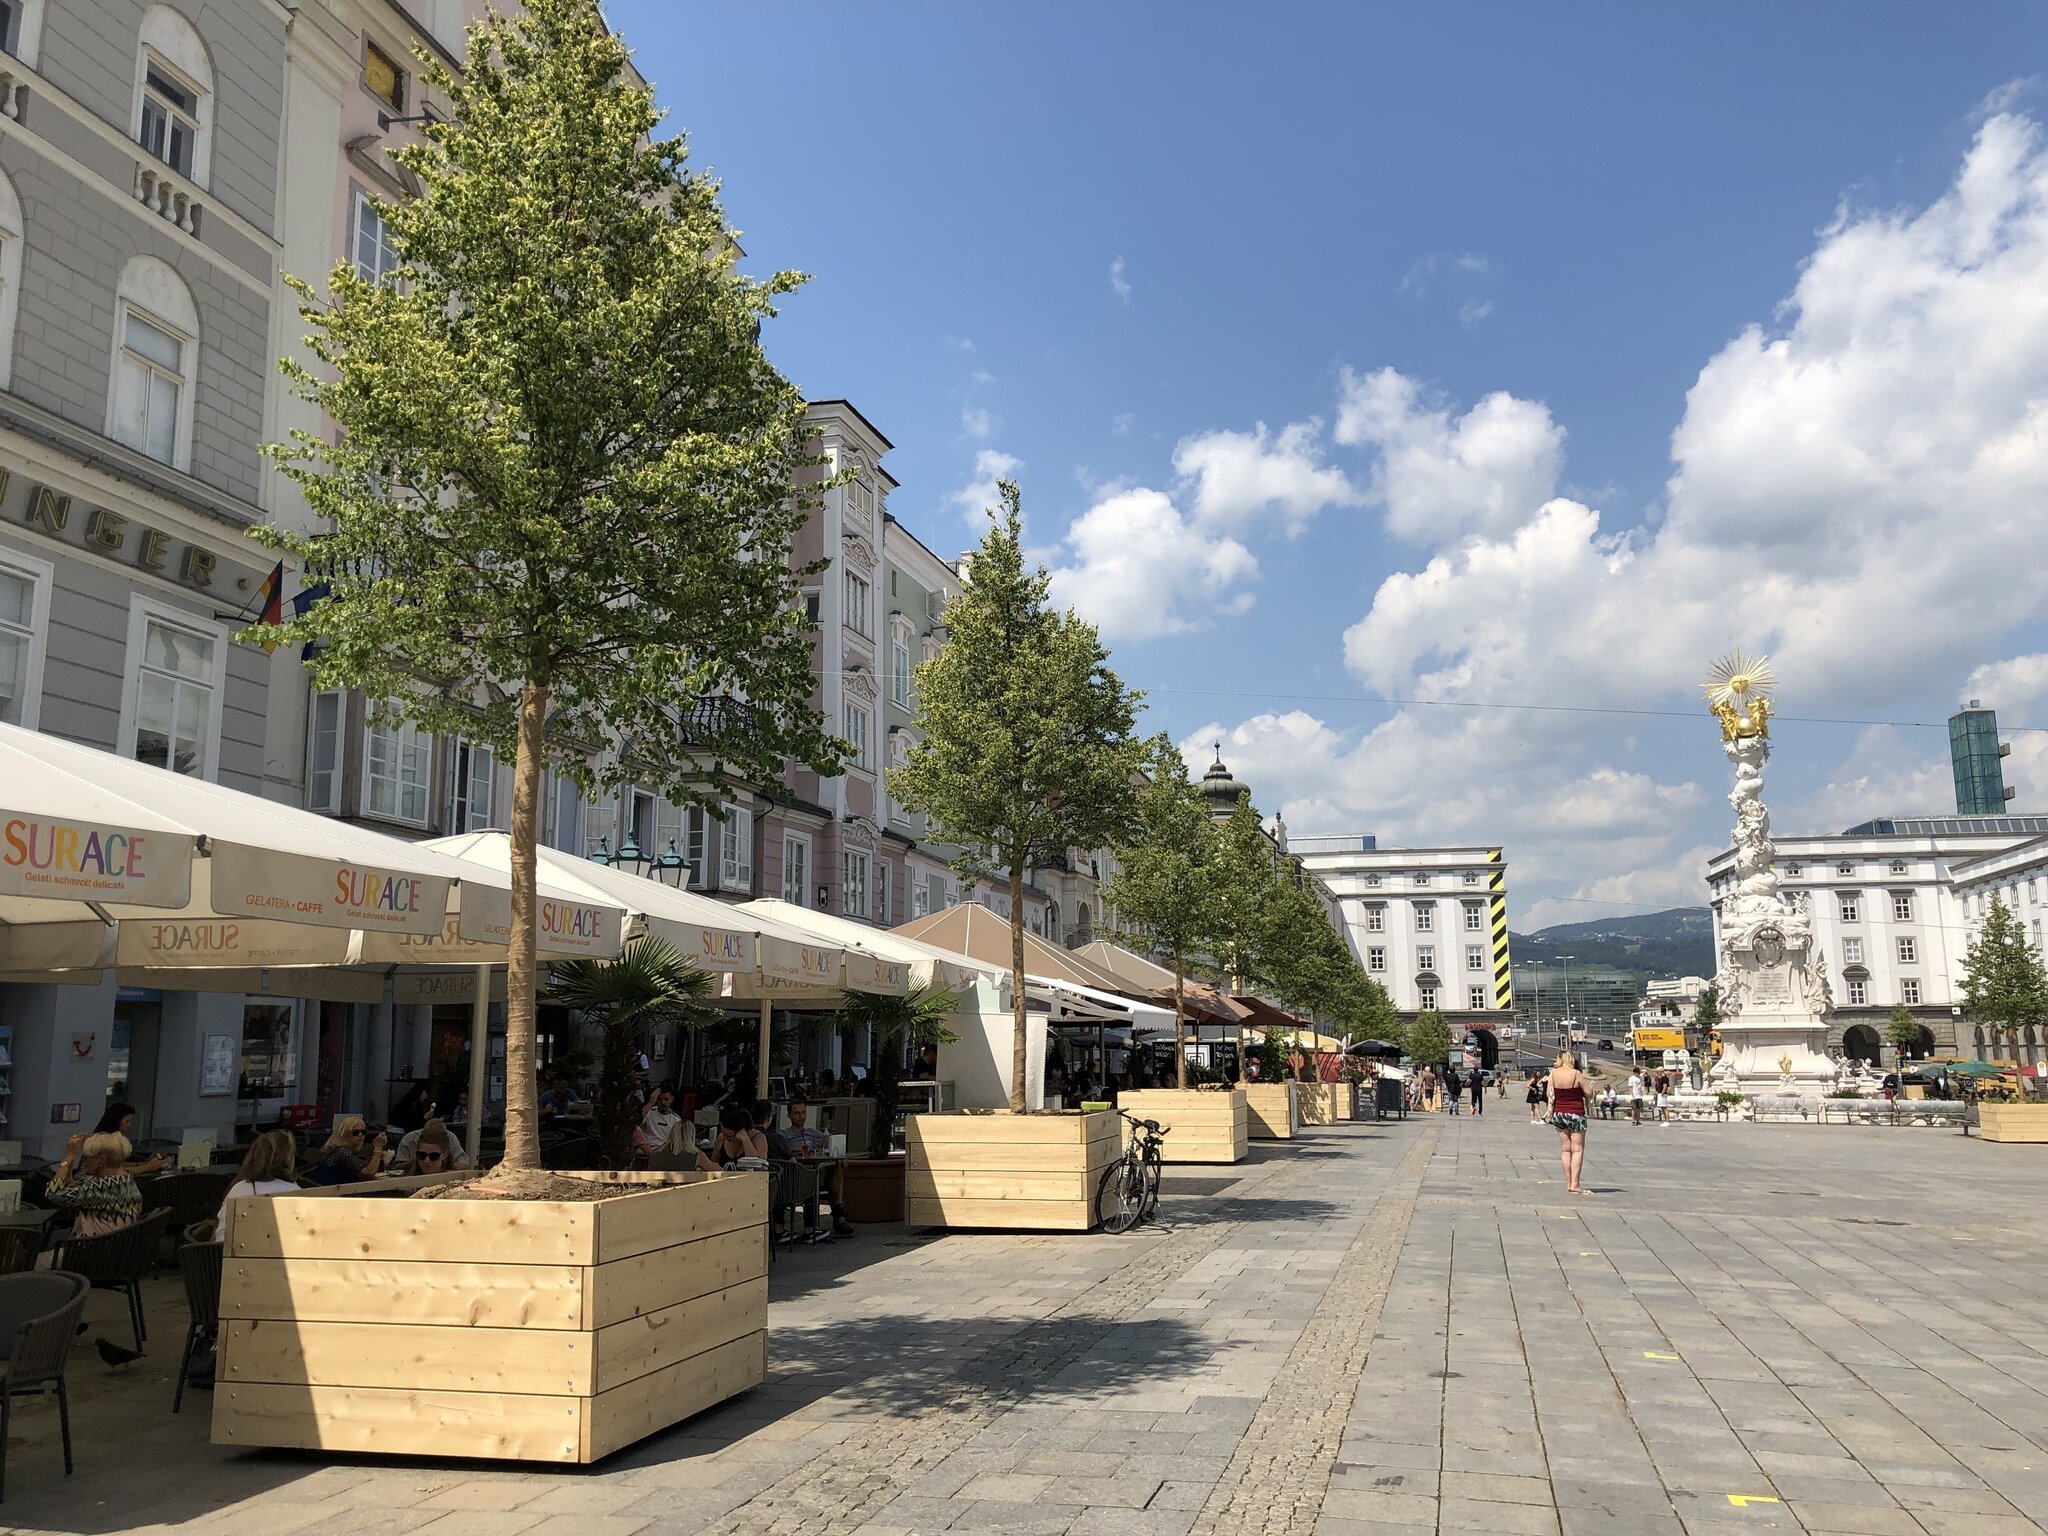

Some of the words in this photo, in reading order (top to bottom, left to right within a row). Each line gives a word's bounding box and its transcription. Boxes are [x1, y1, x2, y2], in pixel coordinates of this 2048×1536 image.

[3, 819, 146, 878] SURACE
[25, 872, 52, 884] Gelati
[54, 875, 92, 888] schmeckt
[92, 878, 125, 890] delicati
[335, 868, 422, 913] SURACE
[245, 894, 289, 910] GELATERIA
[541, 902, 601, 939] SURACE
[703, 931, 744, 958] SURACE
[802, 948, 831, 973] SURACE
